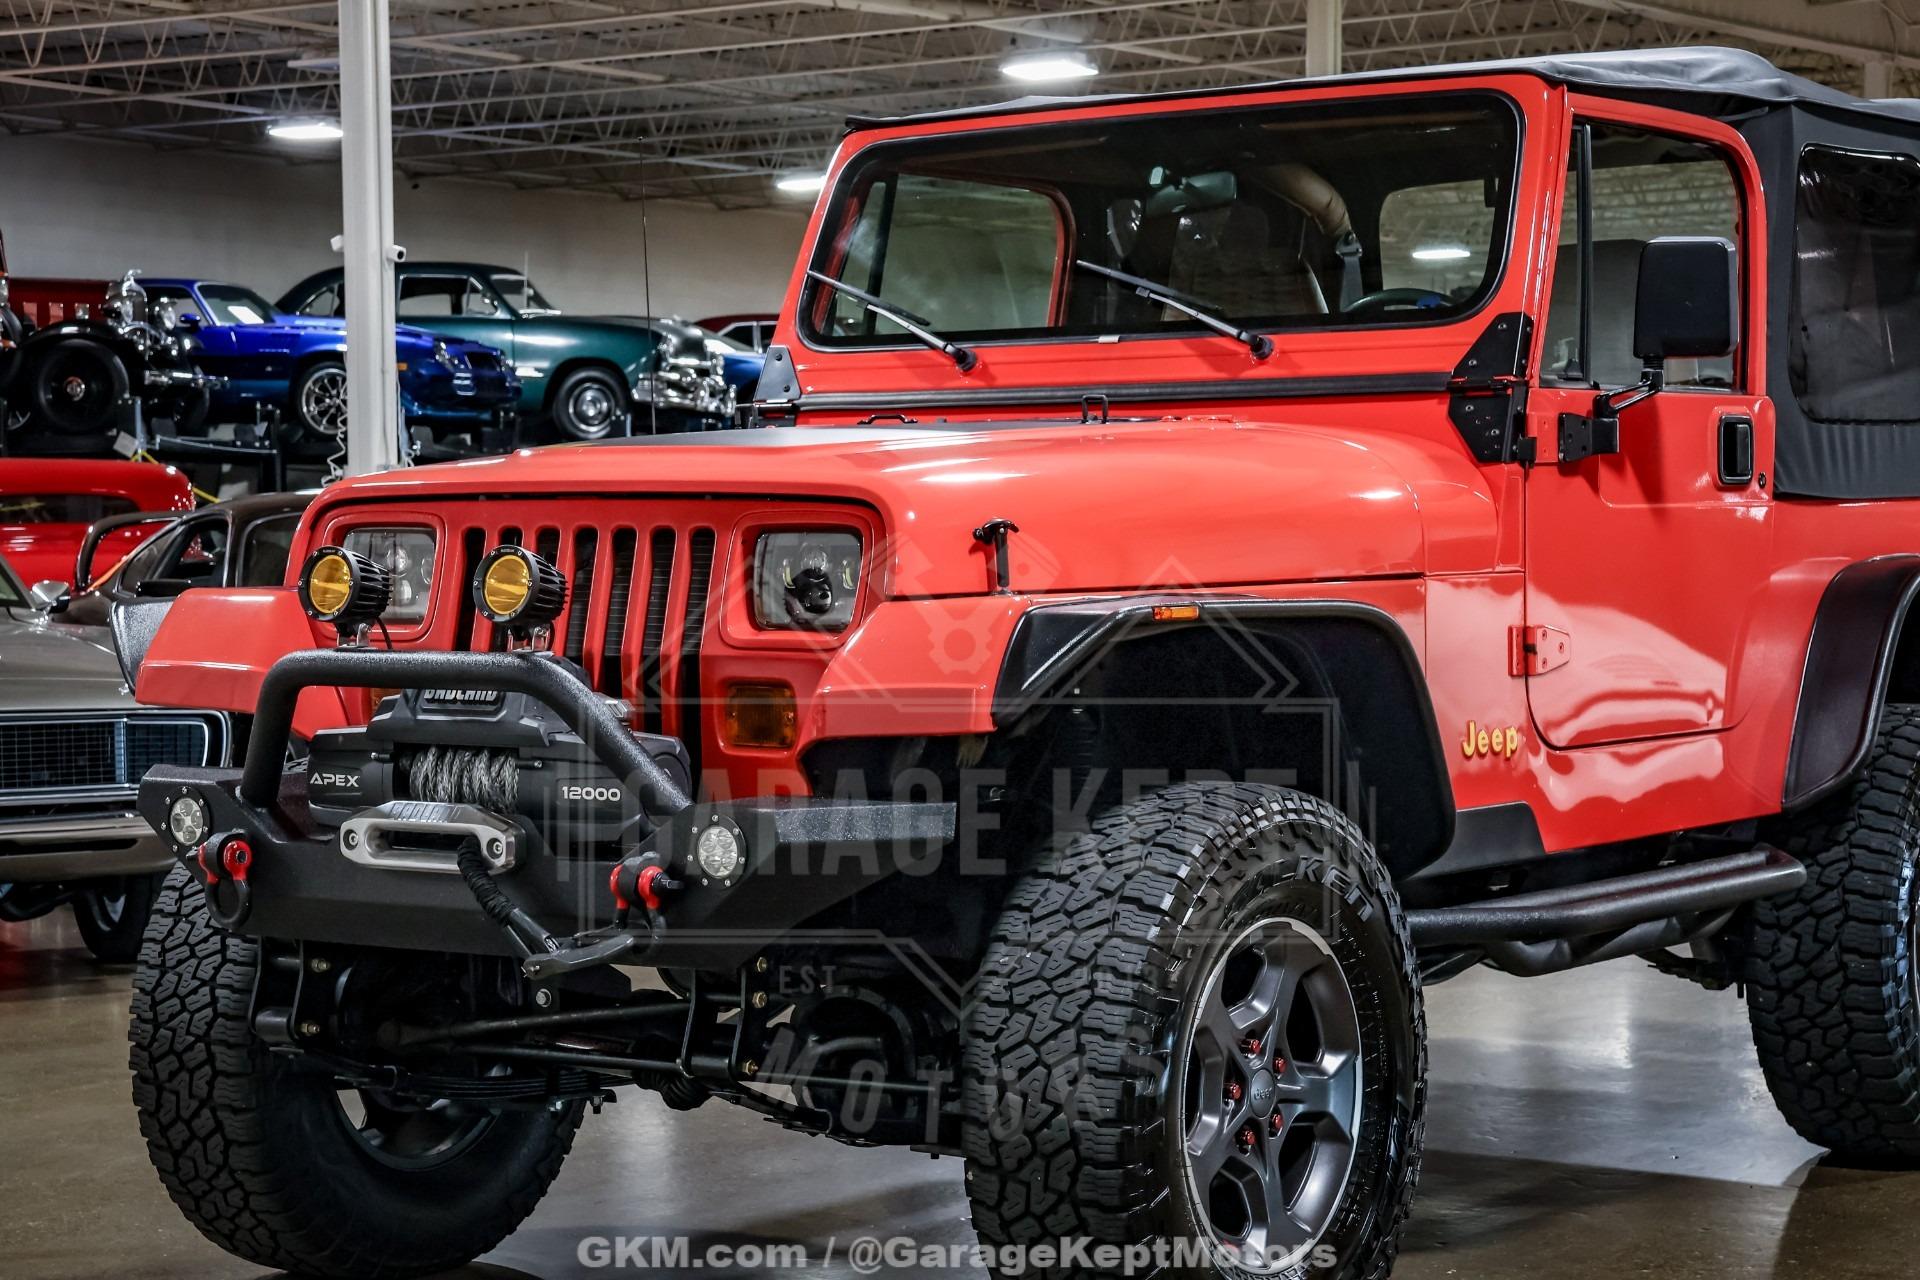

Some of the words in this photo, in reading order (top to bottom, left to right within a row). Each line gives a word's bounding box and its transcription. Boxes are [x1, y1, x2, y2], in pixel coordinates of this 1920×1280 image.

[1461, 720, 1519, 759] Jeep
[309, 772, 360, 788] APEX
[562, 786, 621, 801] 12000
